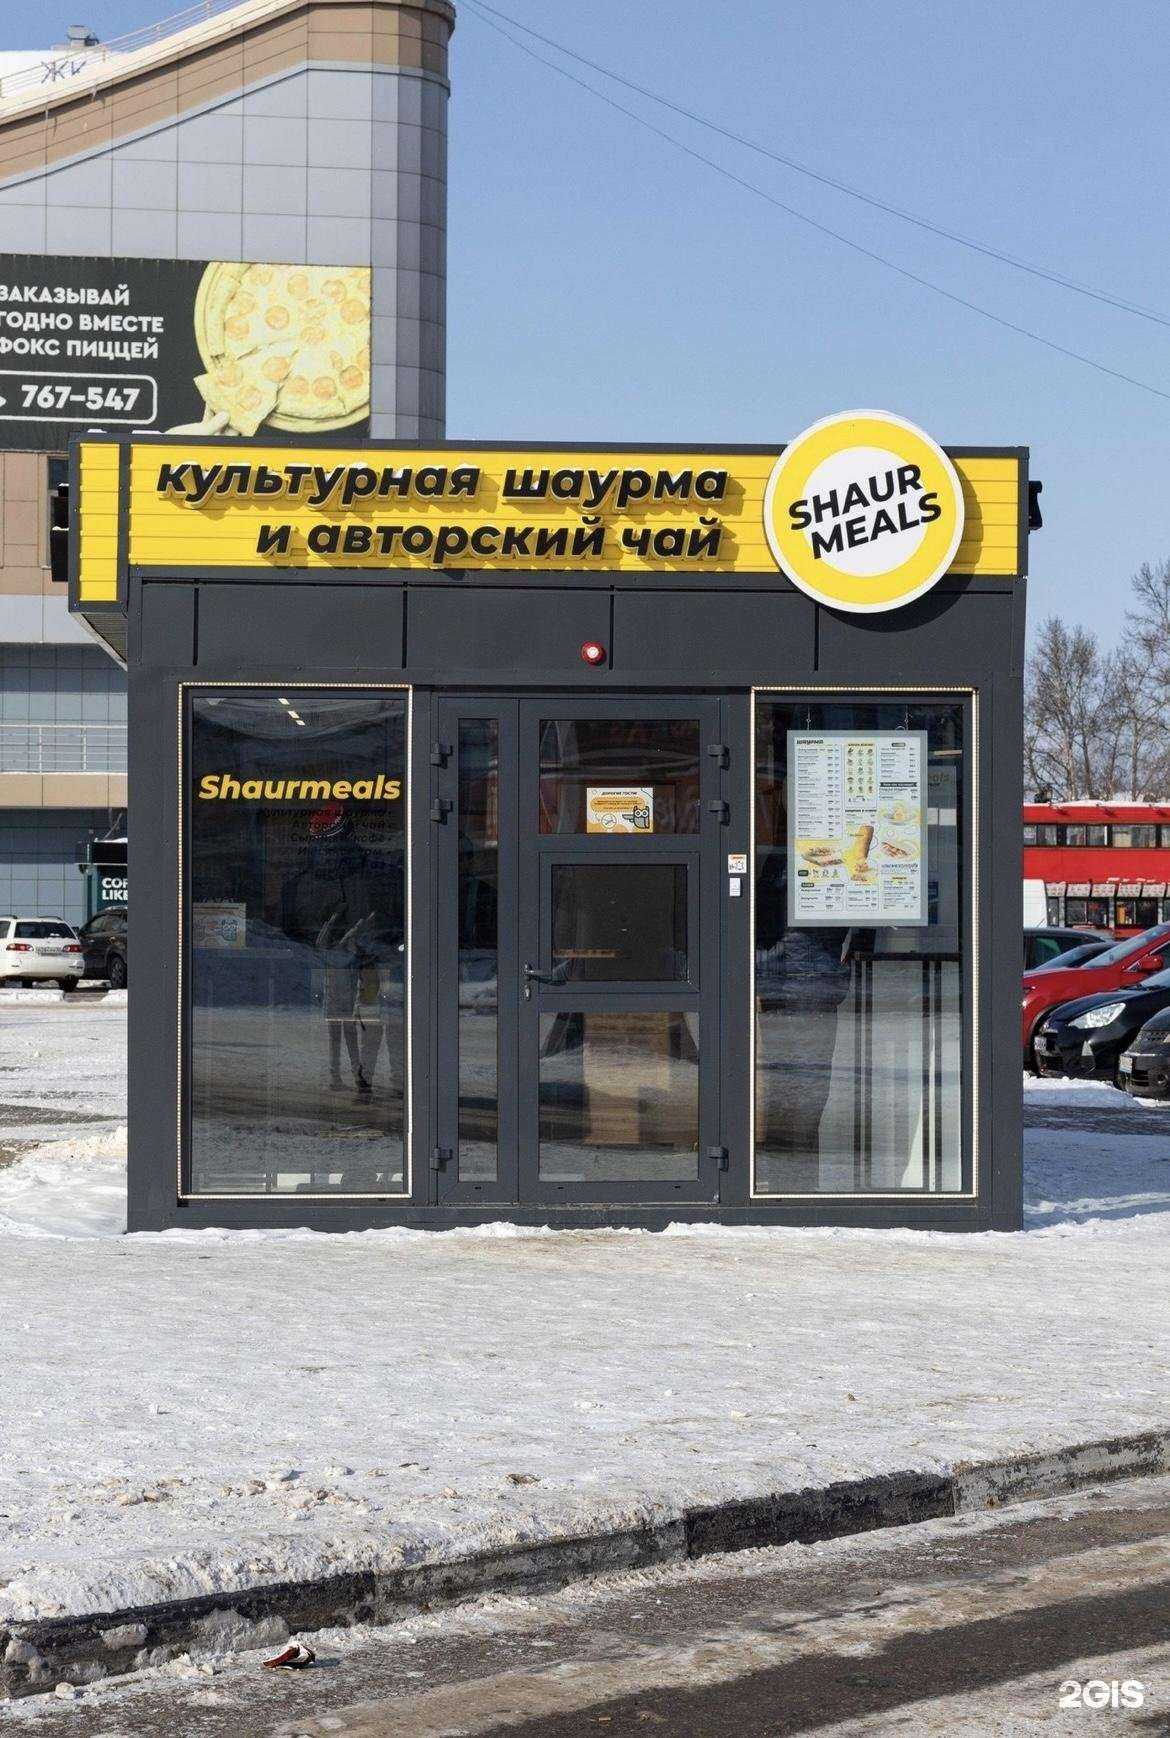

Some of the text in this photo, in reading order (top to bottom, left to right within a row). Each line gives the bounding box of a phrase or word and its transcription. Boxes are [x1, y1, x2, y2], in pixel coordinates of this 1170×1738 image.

[0, 284, 130, 306] ЗАКАЗЫВАЙ
[79, 314, 164, 333] ВМЕСТЕ
[0, 336, 159, 361] ФОКС ПИЦЦЕЙ
[21, 384, 141, 411] 767-547
[157, 463, 728, 509] культурная шаурма
[788, 464, 924, 530] SHAUR
[811, 492, 942, 560] MEALS
[256, 516, 723, 564] и авторский чай
[198, 774, 401, 800] Shaurmeals
